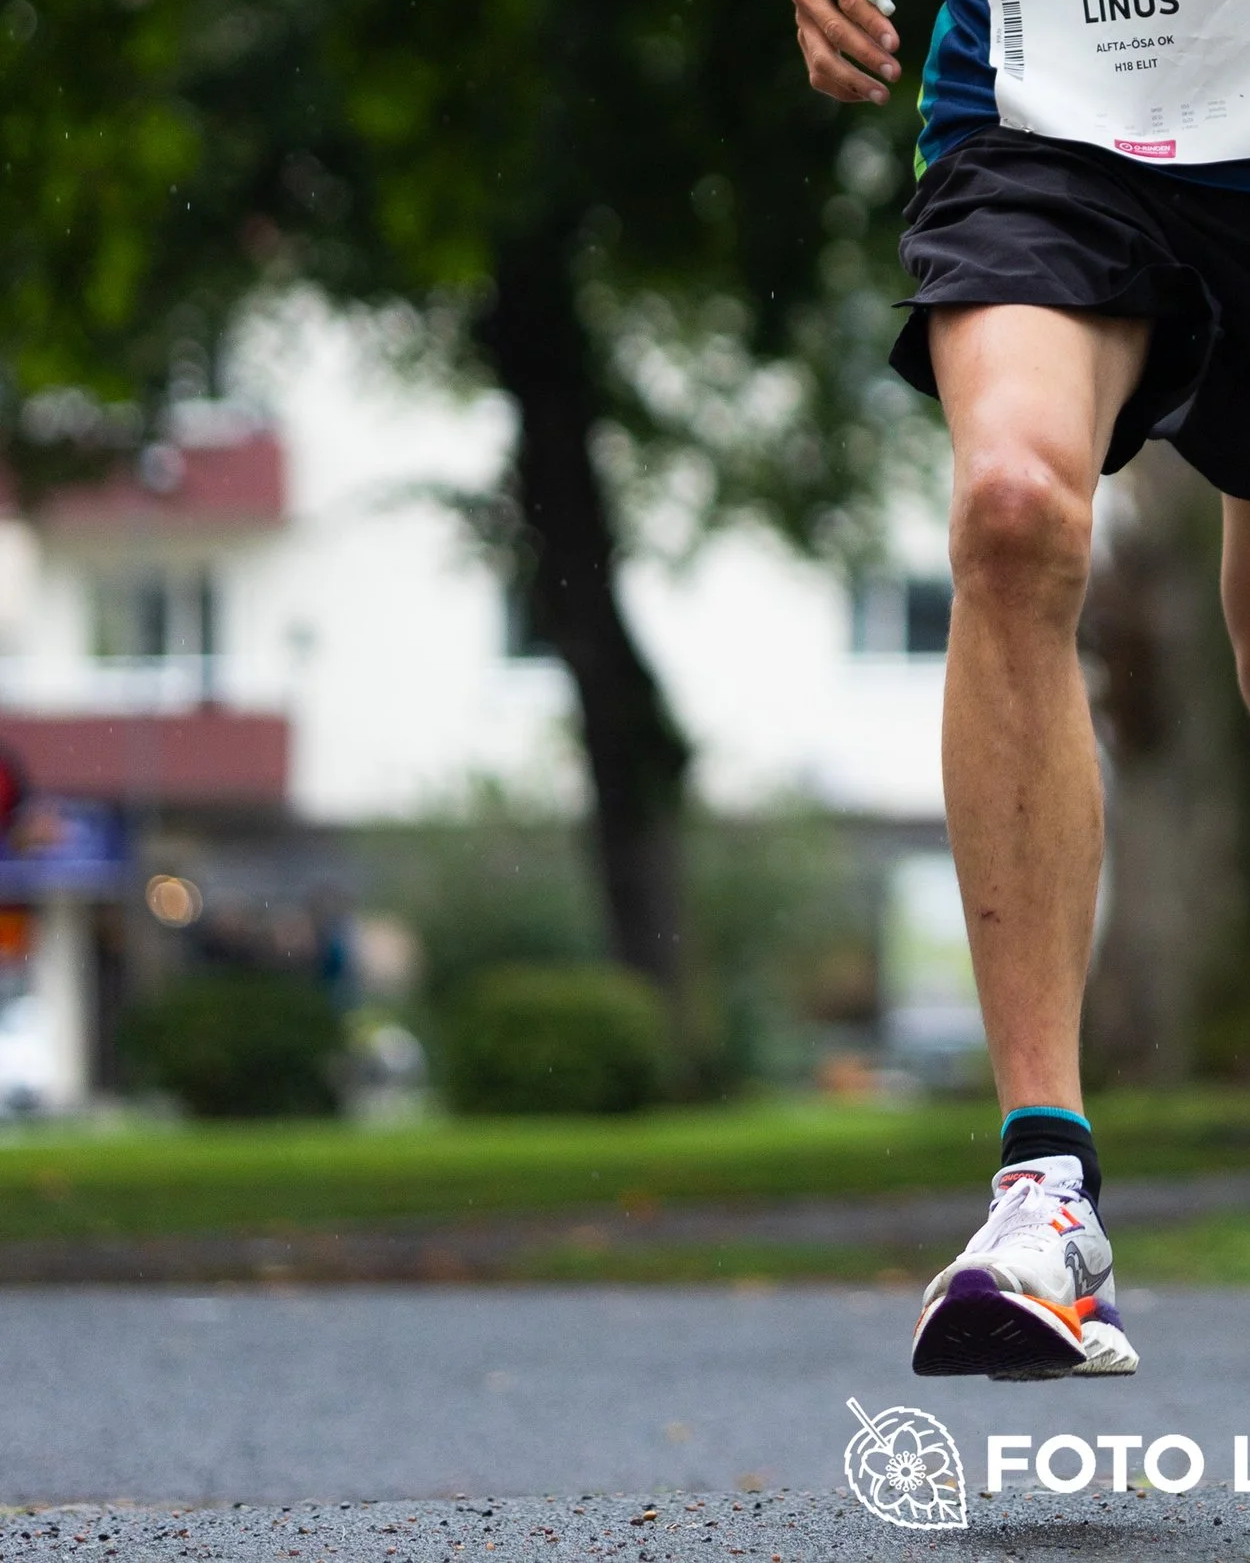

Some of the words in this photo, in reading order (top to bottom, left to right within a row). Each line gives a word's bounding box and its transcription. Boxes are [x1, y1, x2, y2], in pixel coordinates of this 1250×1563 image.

[1096, 37, 1155, 53] ALFTA-ÖSA
[1157, 35, 1175, 46] OK
[1115, 61, 1134, 72] H18
[1136, 58, 1158, 70] ELIT
